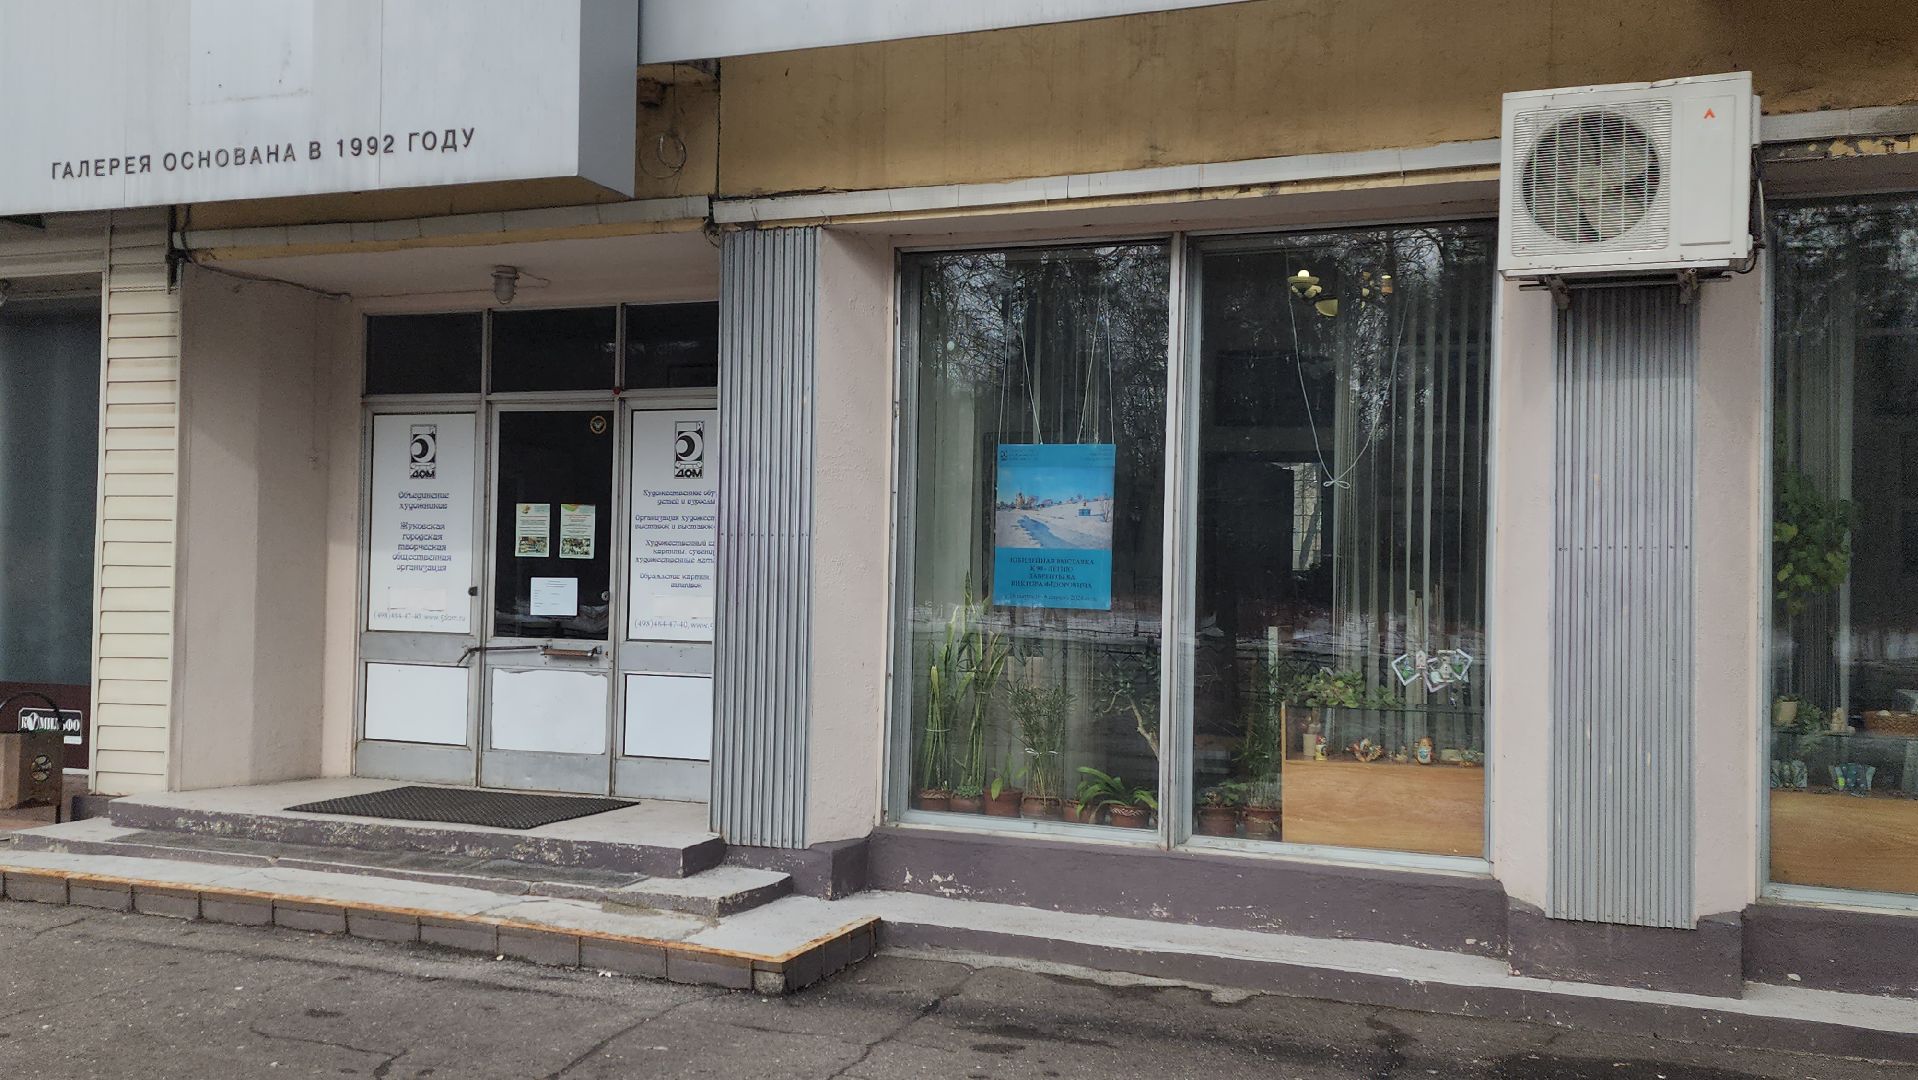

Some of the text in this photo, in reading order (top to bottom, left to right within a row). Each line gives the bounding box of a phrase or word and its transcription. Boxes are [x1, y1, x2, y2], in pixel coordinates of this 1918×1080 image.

[51, 128, 475, 180] ГАЛЕРЕЯ ОСНОВАНА В 1992 ГОДУ
[410, 470, 436, 479] ДОМ
[675, 469, 703, 478] ДОМ
[398, 491, 450, 501] Объединение
[643, 489, 702, 498] Художественное
[399, 503, 448, 511] художников
[635, 514, 679, 522] Организация
[400, 521, 446, 531] Жуковская
[402, 533, 443, 541] городская
[645, 539, 707, 547] Художественный
[397, 544, 447, 552] творческая
[392, 552, 452, 561] общественная
[635, 556, 695, 564] художественные
[396, 564, 447, 573] организация
